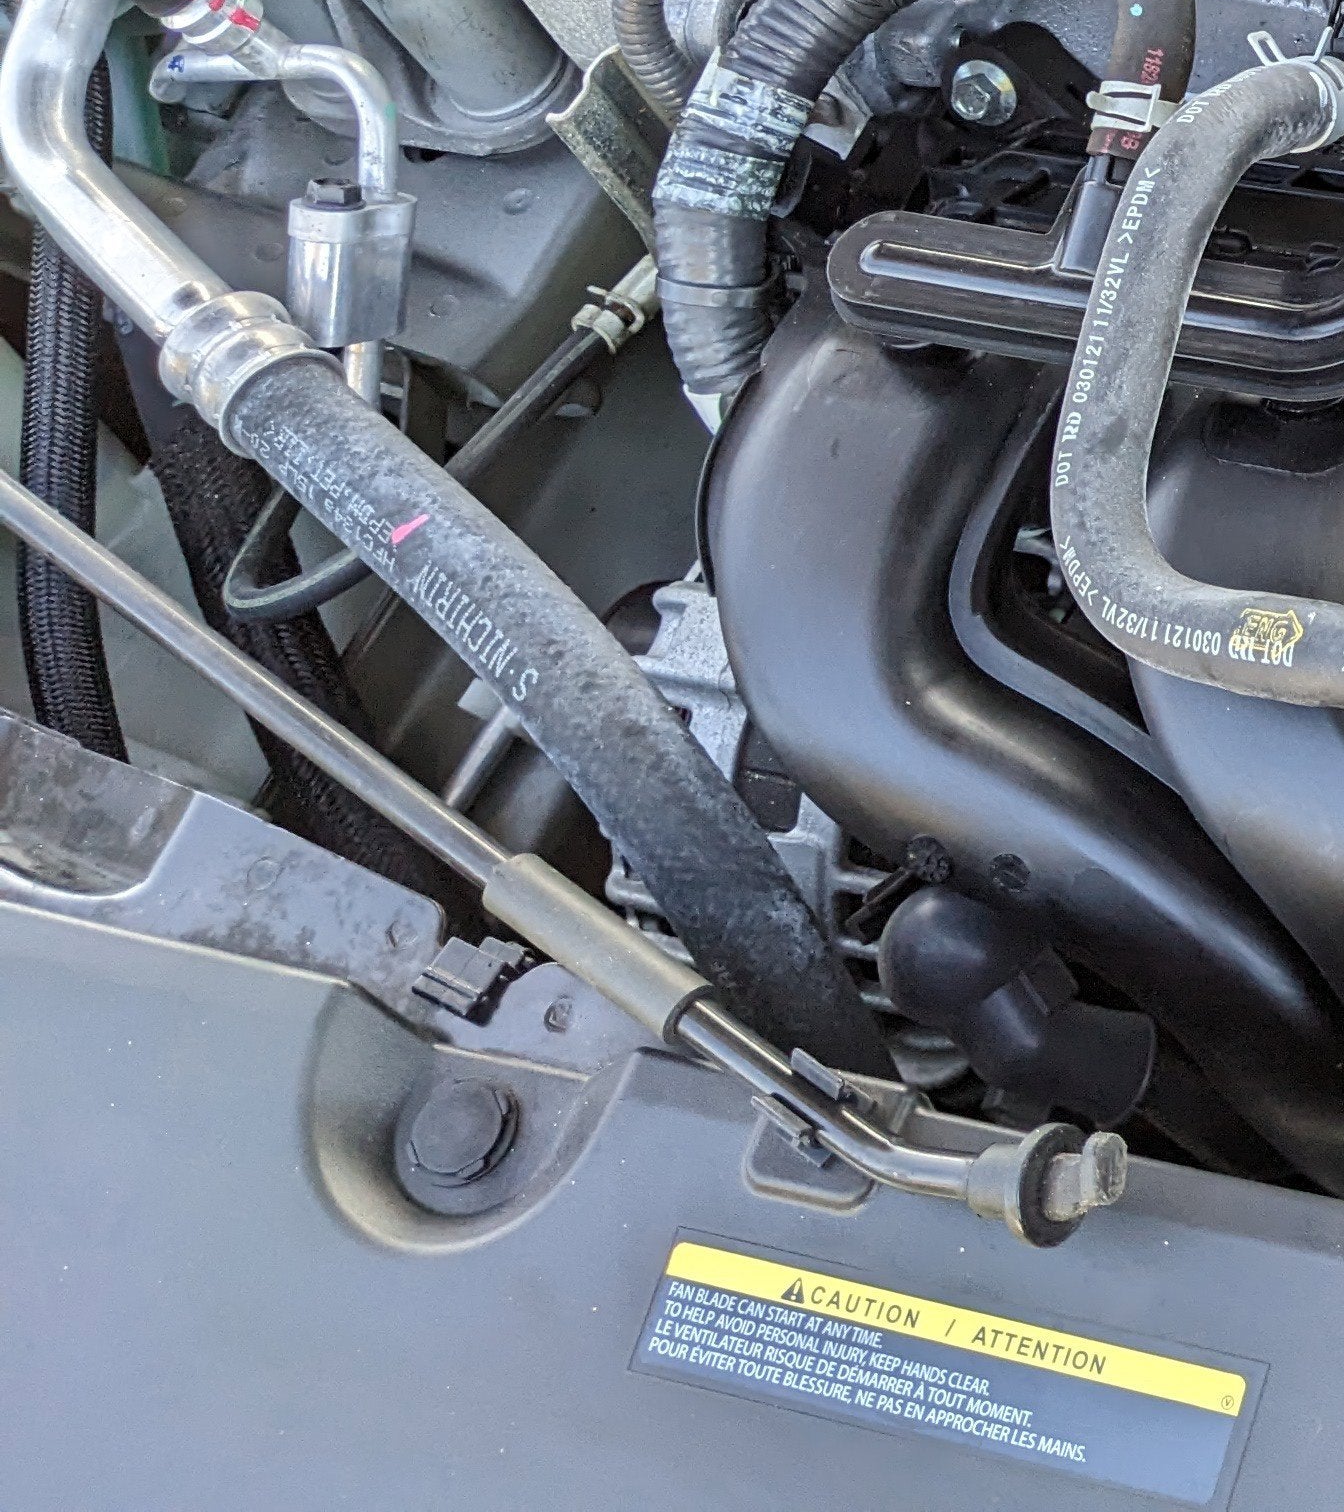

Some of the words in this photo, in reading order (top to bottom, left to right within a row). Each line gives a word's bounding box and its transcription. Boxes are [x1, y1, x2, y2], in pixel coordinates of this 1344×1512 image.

[1055, 450, 1073, 487] DOT
[665, 1300, 681, 1318] TO
[682, 1304, 714, 1326] HELP
[715, 1312, 755, 1337] AVOID
[757, 1322, 818, 1353] PERSONAL
[821, 1336, 868, 1367] INJURY,
[869, 1348, 900, 1371] KEEP
[902, 1355, 945, 1382] HANDS
[948, 1367, 990, 1397] CLEAR.
[669, 1281, 694, 1303] FAN
[696, 1288, 735, 1314] BLADE
[738, 1298, 764, 1320] CAN
[766, 1305, 804, 1329] START
[805, 1314, 821, 1332] AT
[822, 1318, 850, 1338] ANY
[850, 1324, 883, 1348] TIME.
[810, 1285, 920, 1328] CAUTION
[970, 1325, 1107, 1376] ATTENTION
[648, 1338, 687, 1362] POUR
[689, 1346, 735, 1375] ÉVITER
[737, 1360, 781, 1387] TOUTE
[783, 1371, 853, 1406] BLESSURE,
[856, 1389, 875, 1408] NE
[877, 1394, 902, 1416] PAS
[904, 1402, 925, 1420] EN
[927, 1407, 1011, 1444] APPROCHER
[1012, 1428, 1036, 1448] LES
[1037, 1433, 1086, 1463] MAINS.
[656, 1319, 670, 1334] LE
[671, 1322, 763, 1359] VENTILATEUR
[764, 1343, 812, 1372] RISQUE
[815, 1356, 835, 1375] DE
[838, 1358, 912, 1398] DÉMARRER
[913, 1376, 925, 1399] À
[927, 1383, 964, 1409] TOUT
[967, 1394, 1032, 1427] MOMENT.
